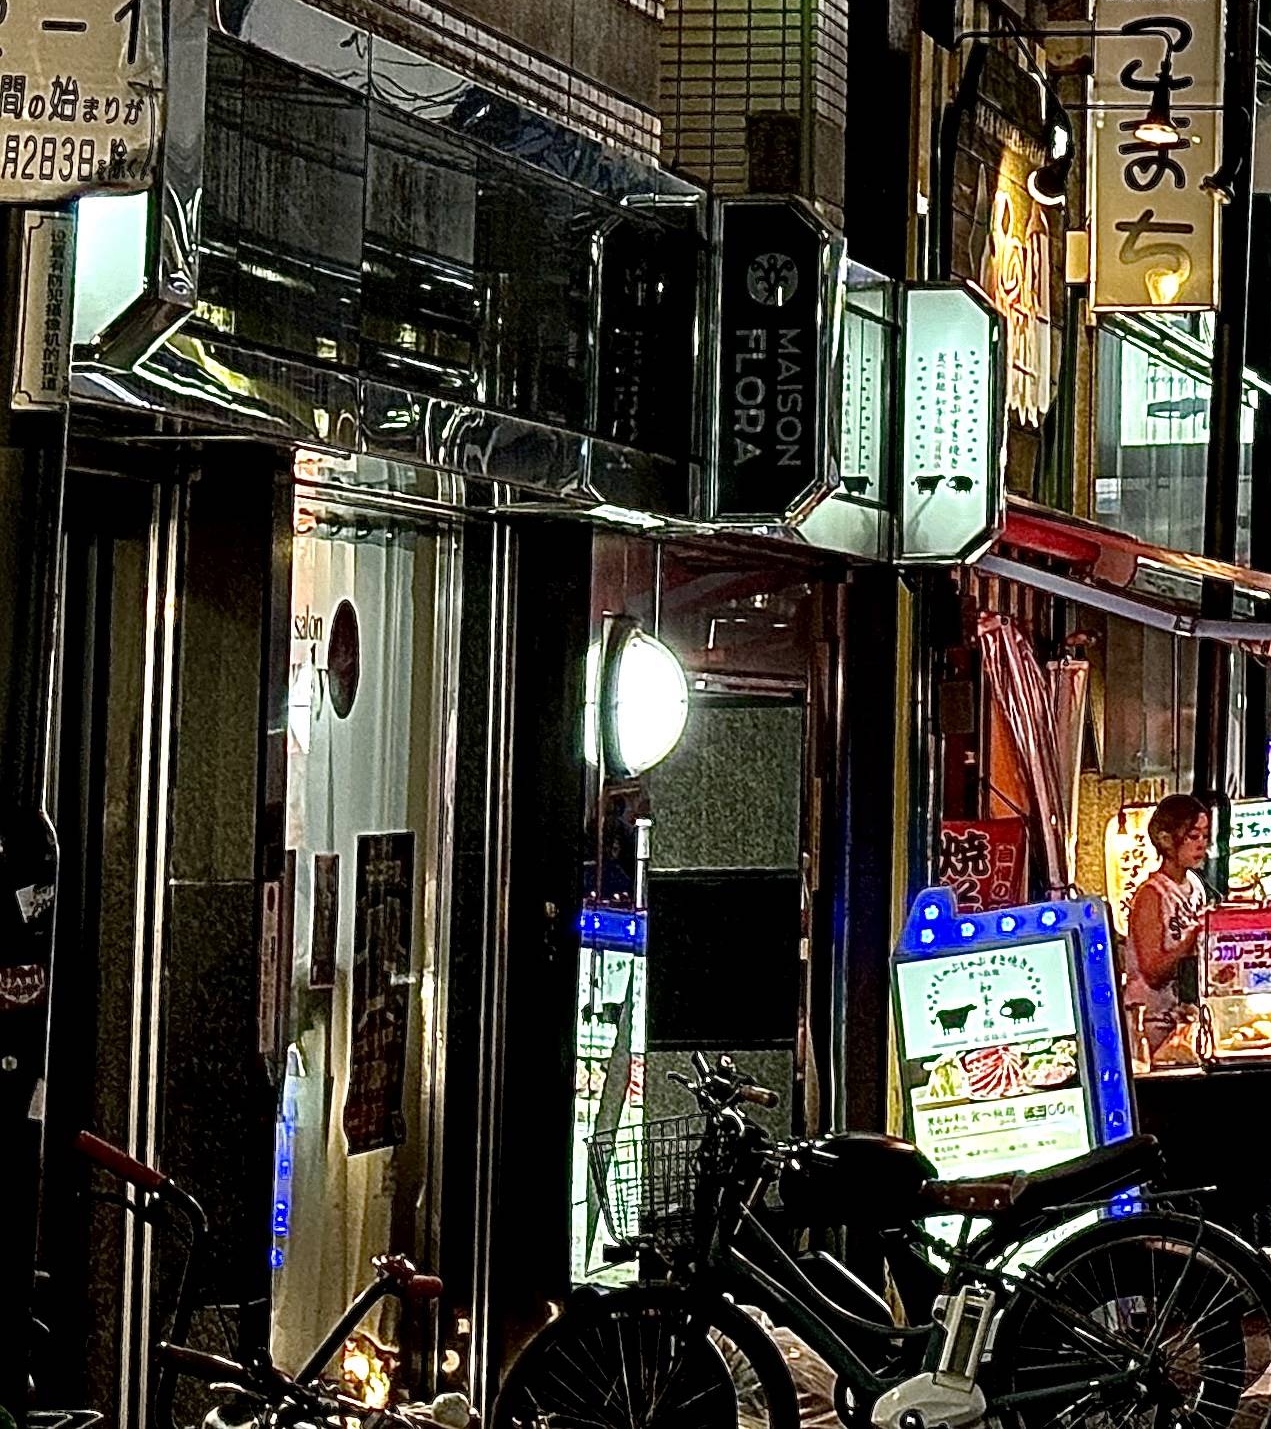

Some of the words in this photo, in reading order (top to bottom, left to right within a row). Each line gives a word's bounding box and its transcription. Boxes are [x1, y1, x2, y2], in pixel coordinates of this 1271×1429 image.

[733, 328, 767, 466] FLORA
[776, 328, 802, 467] MAISON
[294, 604, 324, 642] salon
